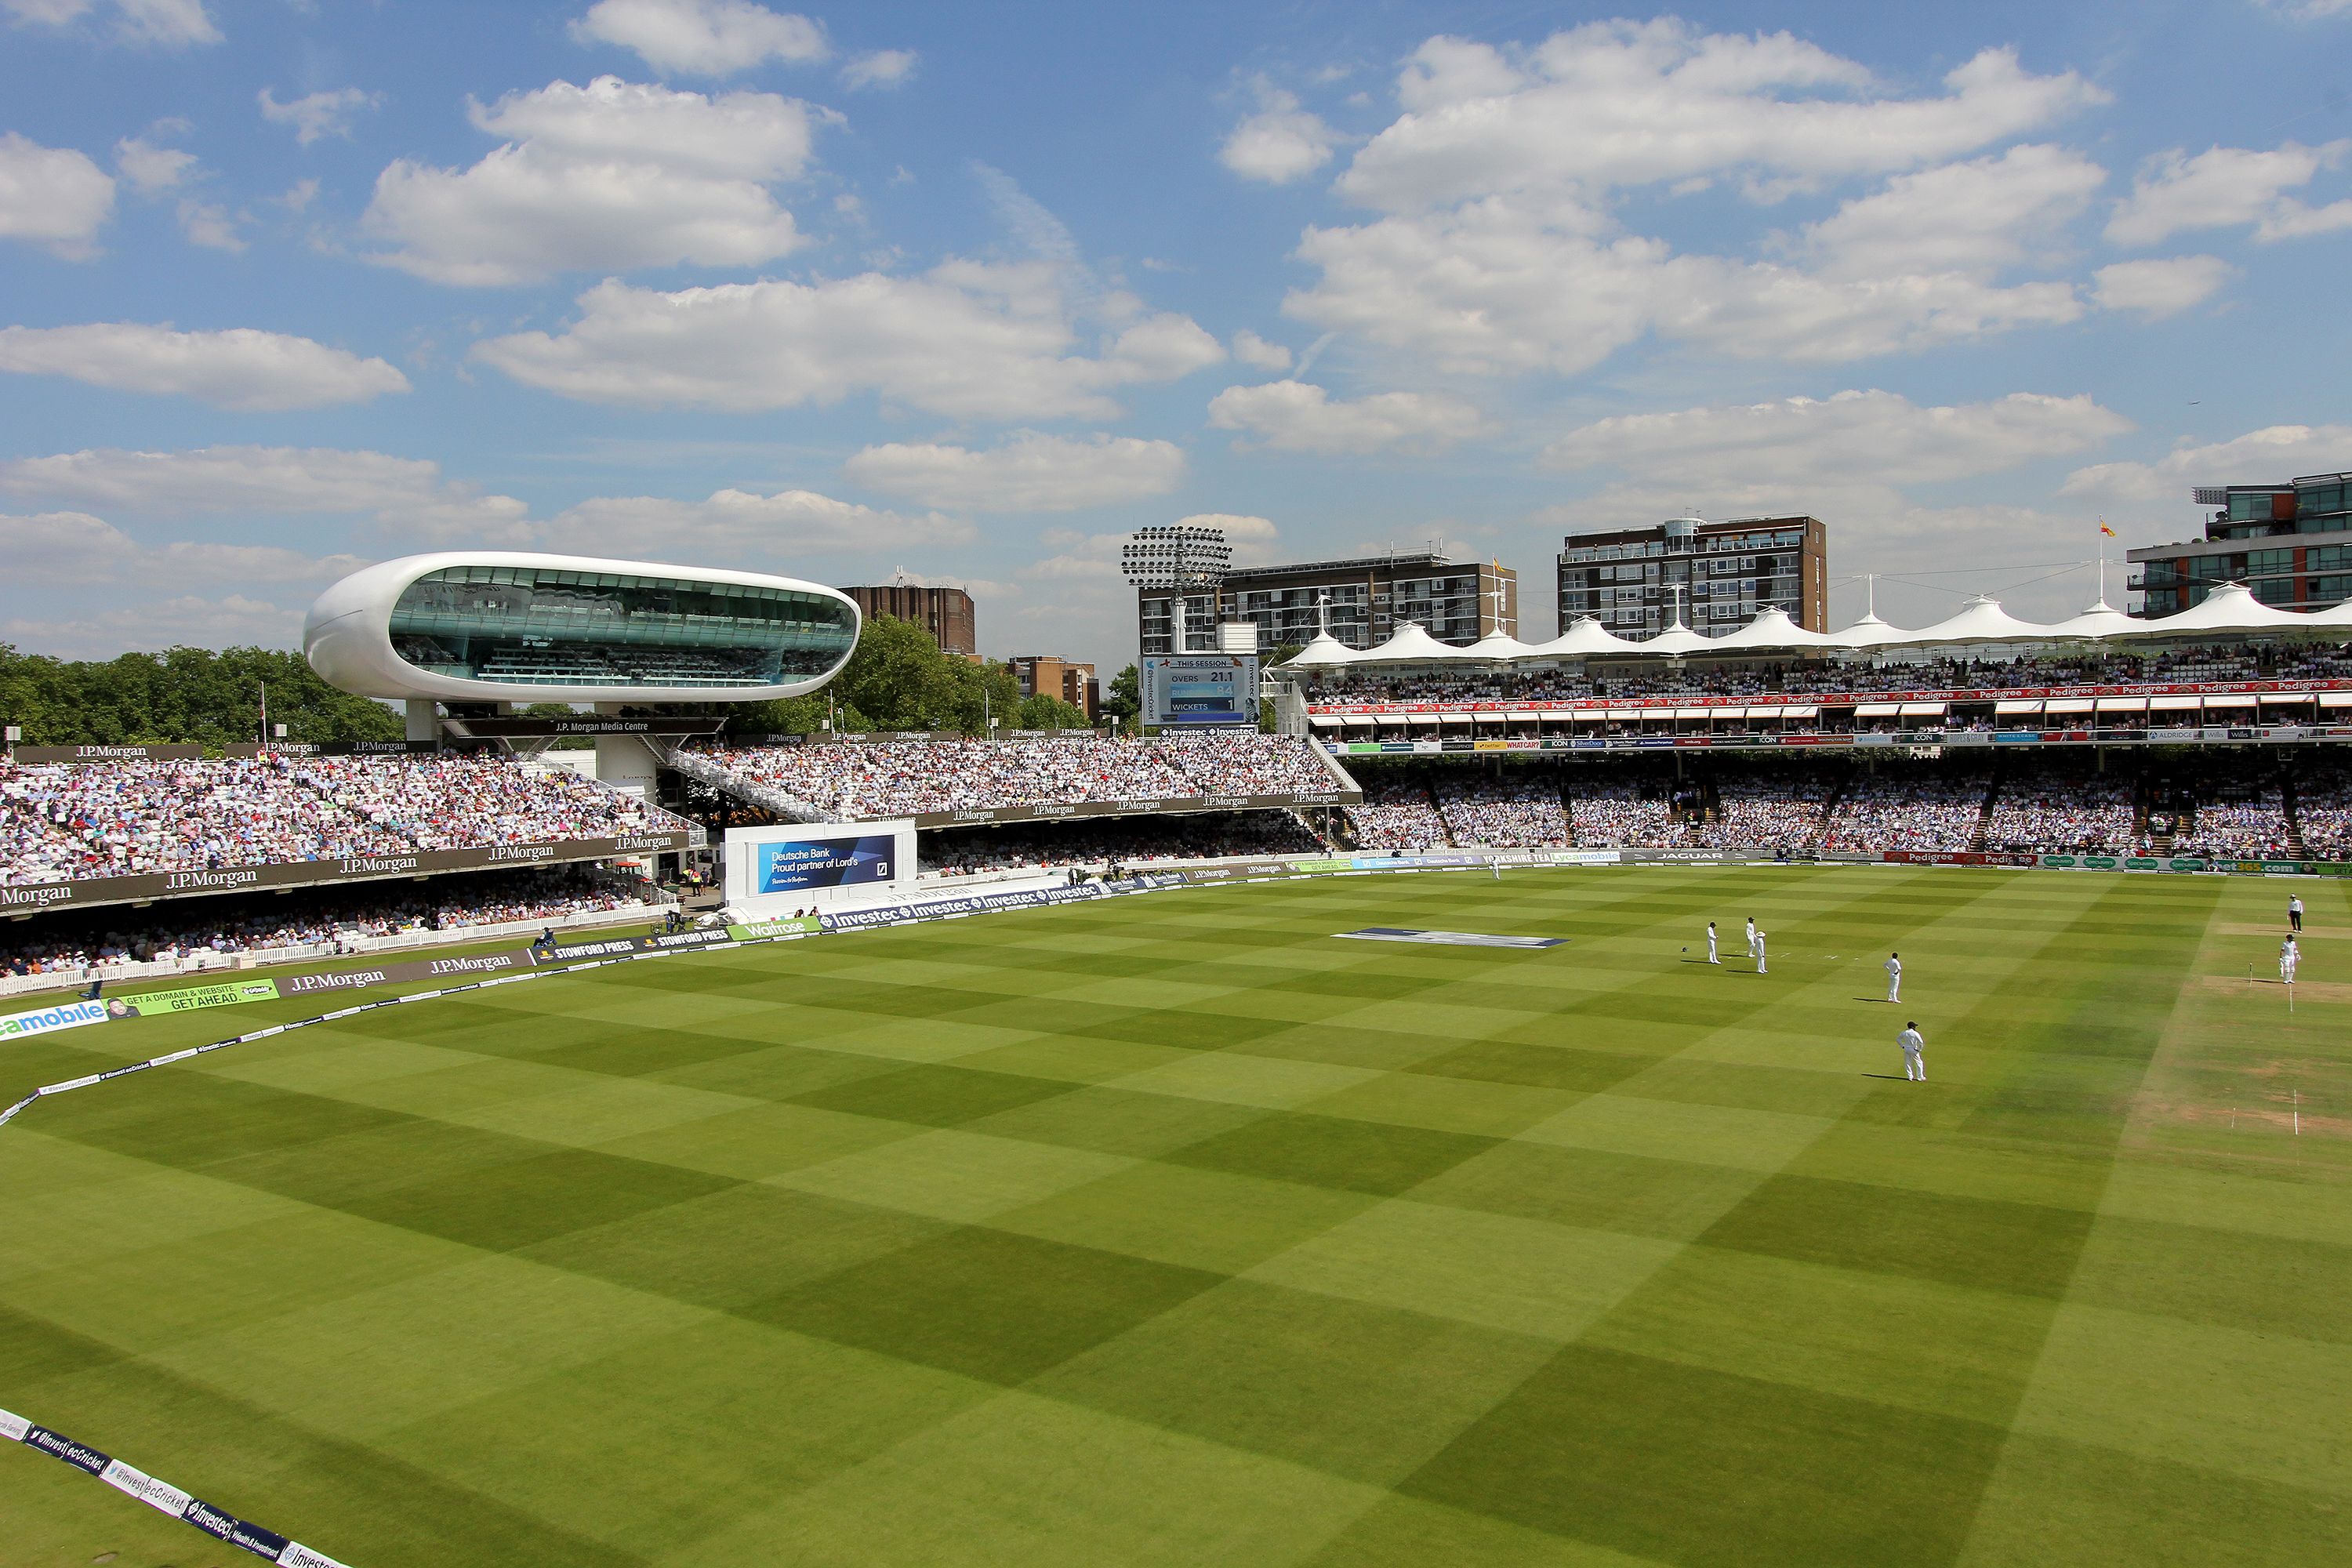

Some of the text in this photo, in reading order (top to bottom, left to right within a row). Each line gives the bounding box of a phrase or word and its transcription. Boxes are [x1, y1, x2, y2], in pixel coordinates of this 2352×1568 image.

[1210, 672, 1232, 681] 21.1
[2122, 685, 2169, 695] Pedigree
[2198, 683, 2247, 693] Pedigree
[2278, 681, 2328, 691] Pedigree
[1849, 693, 1888, 702] Pedigree
[1913, 691, 1954, 702] Pedigree
[1980, 689, 2022, 699] Pedigree
[2049, 687, 2093, 697] Pedigree
[1228, 699, 1233, 710] 1
[1787, 695, 1825, 704] Pedigree
[1494, 702, 1530, 711] Pedigree
[1551, 701, 1587, 710] Pedigree
[571, 723, 599, 733] Morgan
[1011, 728, 1045, 738] J.P.Morgan
[1060, 728, 1094, 738] J.P.Morgan
[766, 734, 801, 742] J.P.Morgan
[895, 731, 931, 740] J.P.Morgan
[354, 741, 406, 752] J.P.Morgan
[76, 746, 147, 759] J.P.Morgan
[1203, 797, 1248, 808] J.P.Morgan
[1292, 794, 1339, 804] J.P.Morgan
[1033, 805, 1075, 816] J.P.Morgan
[1116, 801, 1160, 811] J.P.Morgan
[953, 810, 994, 822] J.P.Morgan
[615, 835, 672, 851] J.P.Morgan
[488, 844, 554, 861] J.P.Morgan
[771, 848, 830, 862] Deutsche Bank
[1533, 854, 1551, 862] TEA
[1552, 852, 1619, 862] Lycamobile
[1909, 853, 1954, 862] Pedigree
[339, 856, 418, 874] J.P.Morgan
[771, 857, 858, 873] Proud partner of Lord's
[1247, 863, 1281, 873] J.P.Morgan
[166, 869, 257, 889] J.P.Morgan
[1194, 868, 1231, 879] J.P.Morgan
[887, 887, 973, 902] J.P.Morgan
[1046, 884, 1098, 899] Investec
[981, 893, 1036, 908] Investec
[911, 899, 971, 918] Investec
[833, 908, 901, 927] Investec
[746, 920, 806, 937] Waitrose
[657, 931, 702, 947] STOWFORD
[703, 929, 728, 941] PRESS
[554, 940, 634, 960] STOWFORD PRESS
[430, 953, 512, 974] J.P.Morgan
[292, 969, 387, 992] J.P.Morgan
[127, 996, 143, 1005] GET
[154, 992, 188, 1002] DOMAIN
[198, 985, 238, 996] WEBSITE.
[171, 993, 241, 1010] GET AHEAD.
[194, 1504, 230, 1536] Investec
[232, 1530, 249, 1546] Wealth
[252, 1538, 278, 1559] Investment
